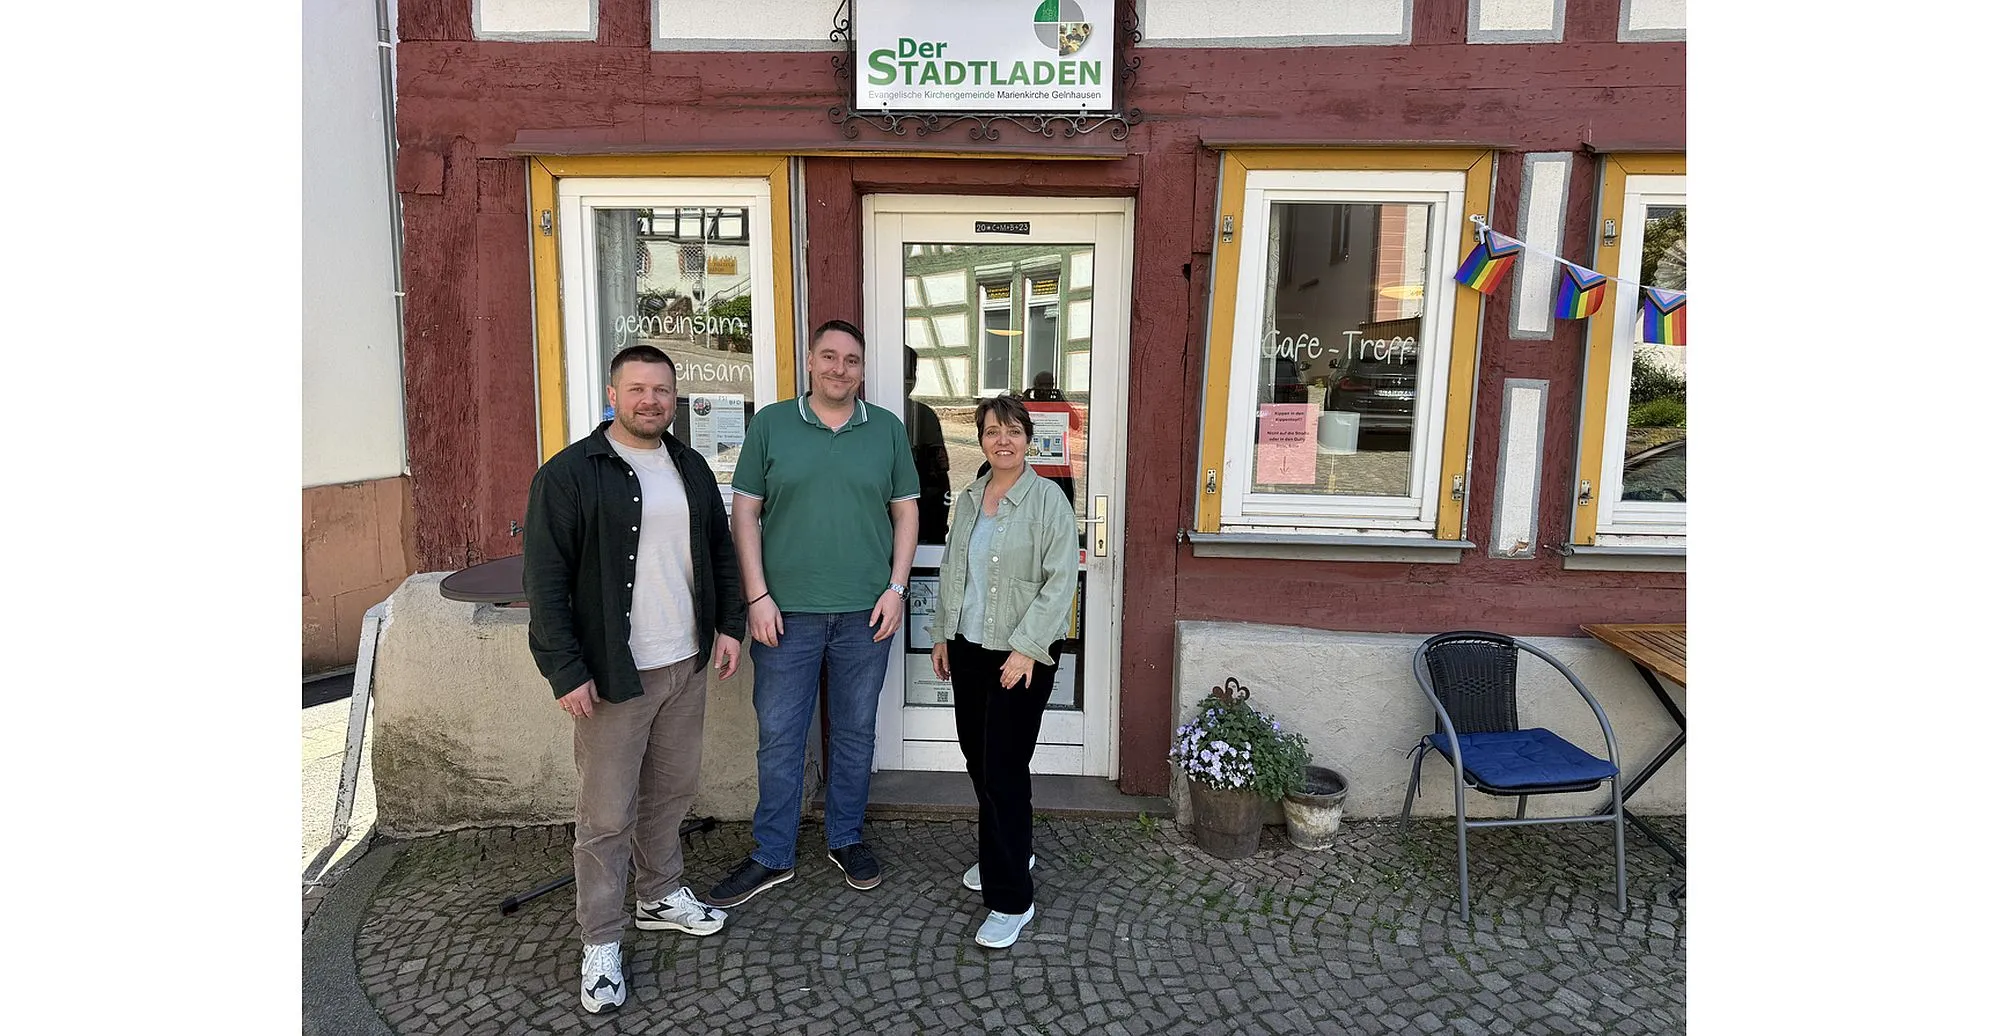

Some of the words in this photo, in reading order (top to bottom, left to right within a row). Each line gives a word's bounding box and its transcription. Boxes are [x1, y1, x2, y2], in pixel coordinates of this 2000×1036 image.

[898, 37, 948, 58] Der
[867, 49, 1101, 85] STADTLADEN
[868, 91, 922, 100] Evangelische
[924, 91, 995, 100] Kirchengemeinde
[997, 91, 1050, 99] Marienkirche
[1051, 91, 1102, 99] Gelnhausen
[675, 359, 752, 382] einsam
